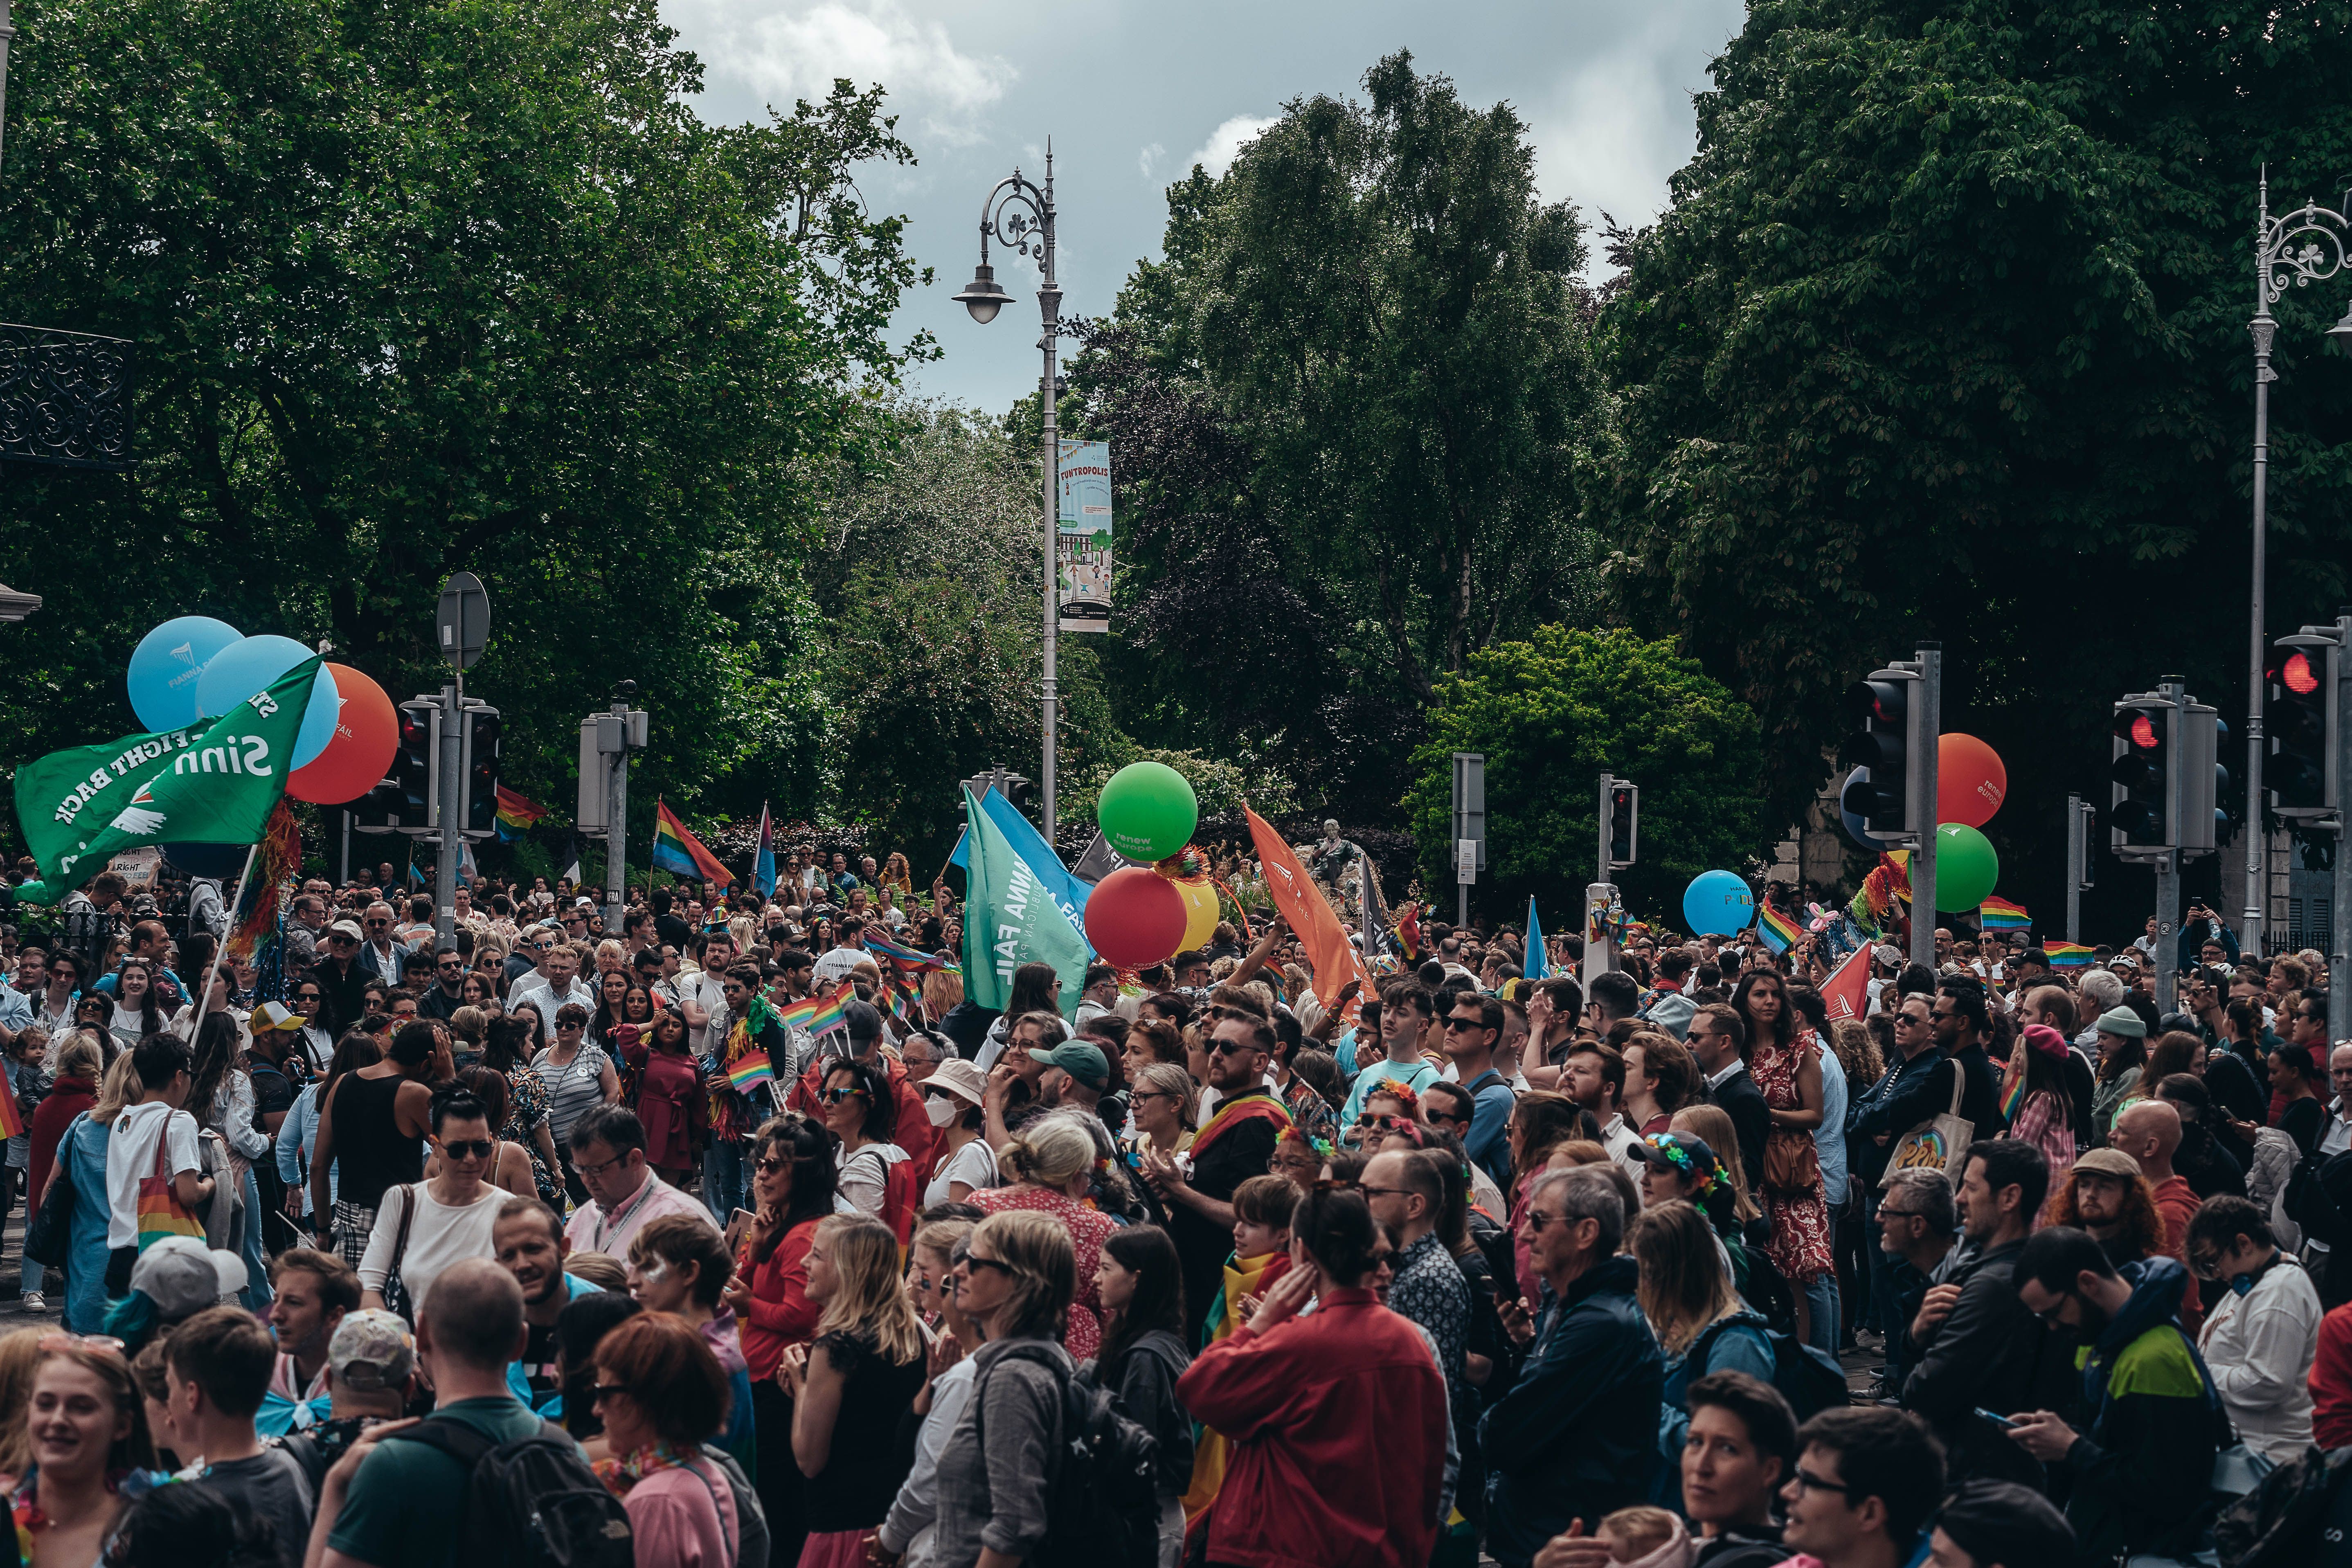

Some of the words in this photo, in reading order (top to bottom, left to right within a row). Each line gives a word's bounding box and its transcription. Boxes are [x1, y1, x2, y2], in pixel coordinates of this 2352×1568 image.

[1060, 466, 1108, 481] FUNTROPOLIS
[168, 666, 203, 688] FIANNA
[336, 733, 351, 742] PARTY
[1985, 780, 2003, 799] renew
[1116, 832, 1151, 845] renew
[116, 862, 141, 871] RIGHT
[1294, 898, 1309, 921] THE
[1132, 956, 1168, 967] renew
[1896, 1143, 1947, 1171] PRIDE
